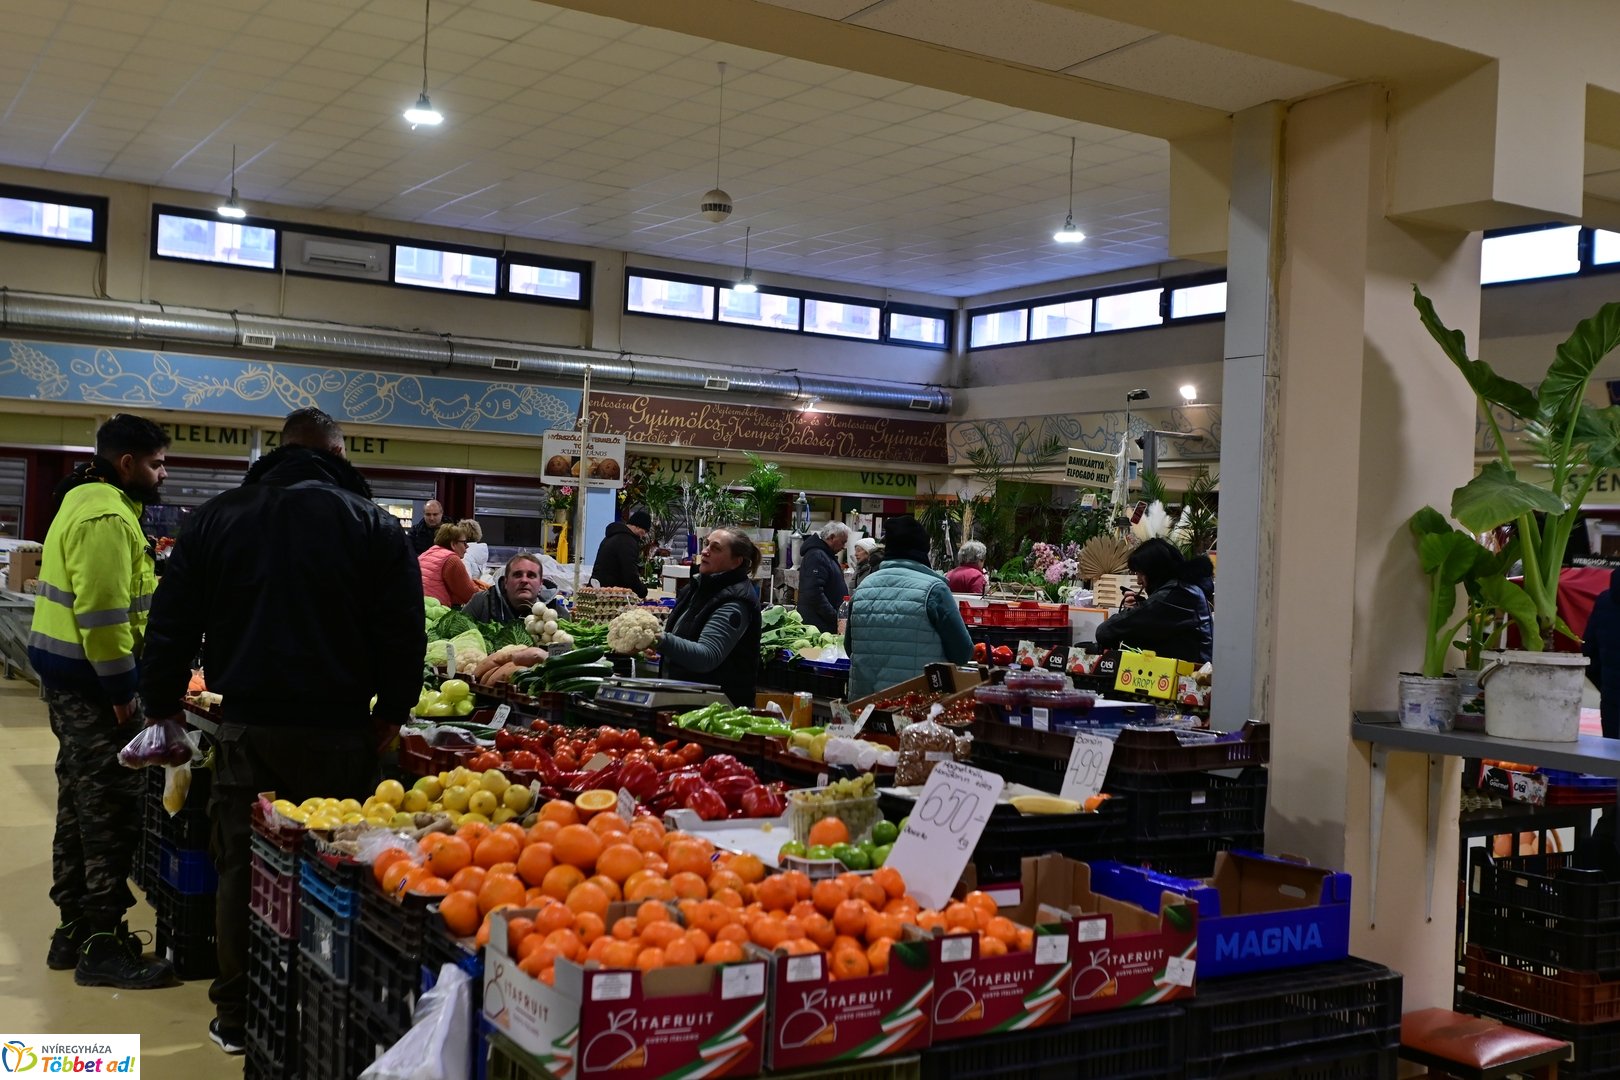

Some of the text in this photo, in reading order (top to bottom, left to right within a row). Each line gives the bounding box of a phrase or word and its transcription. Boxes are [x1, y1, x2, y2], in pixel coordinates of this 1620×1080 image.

[629, 395, 721, 437] Gyümölcs
[778, 423, 835, 455] Zöldség
[836, 431, 885, 459] Virág
[1068, 456, 1104, 470] BANKKÁRTYA
[860, 471, 917, 487] VISZON
[1066, 468, 1110, 483] ELFOGADÓ HELY
[1132, 676, 1156, 689] KROPY
[1216, 922, 1324, 962] MAGNA
